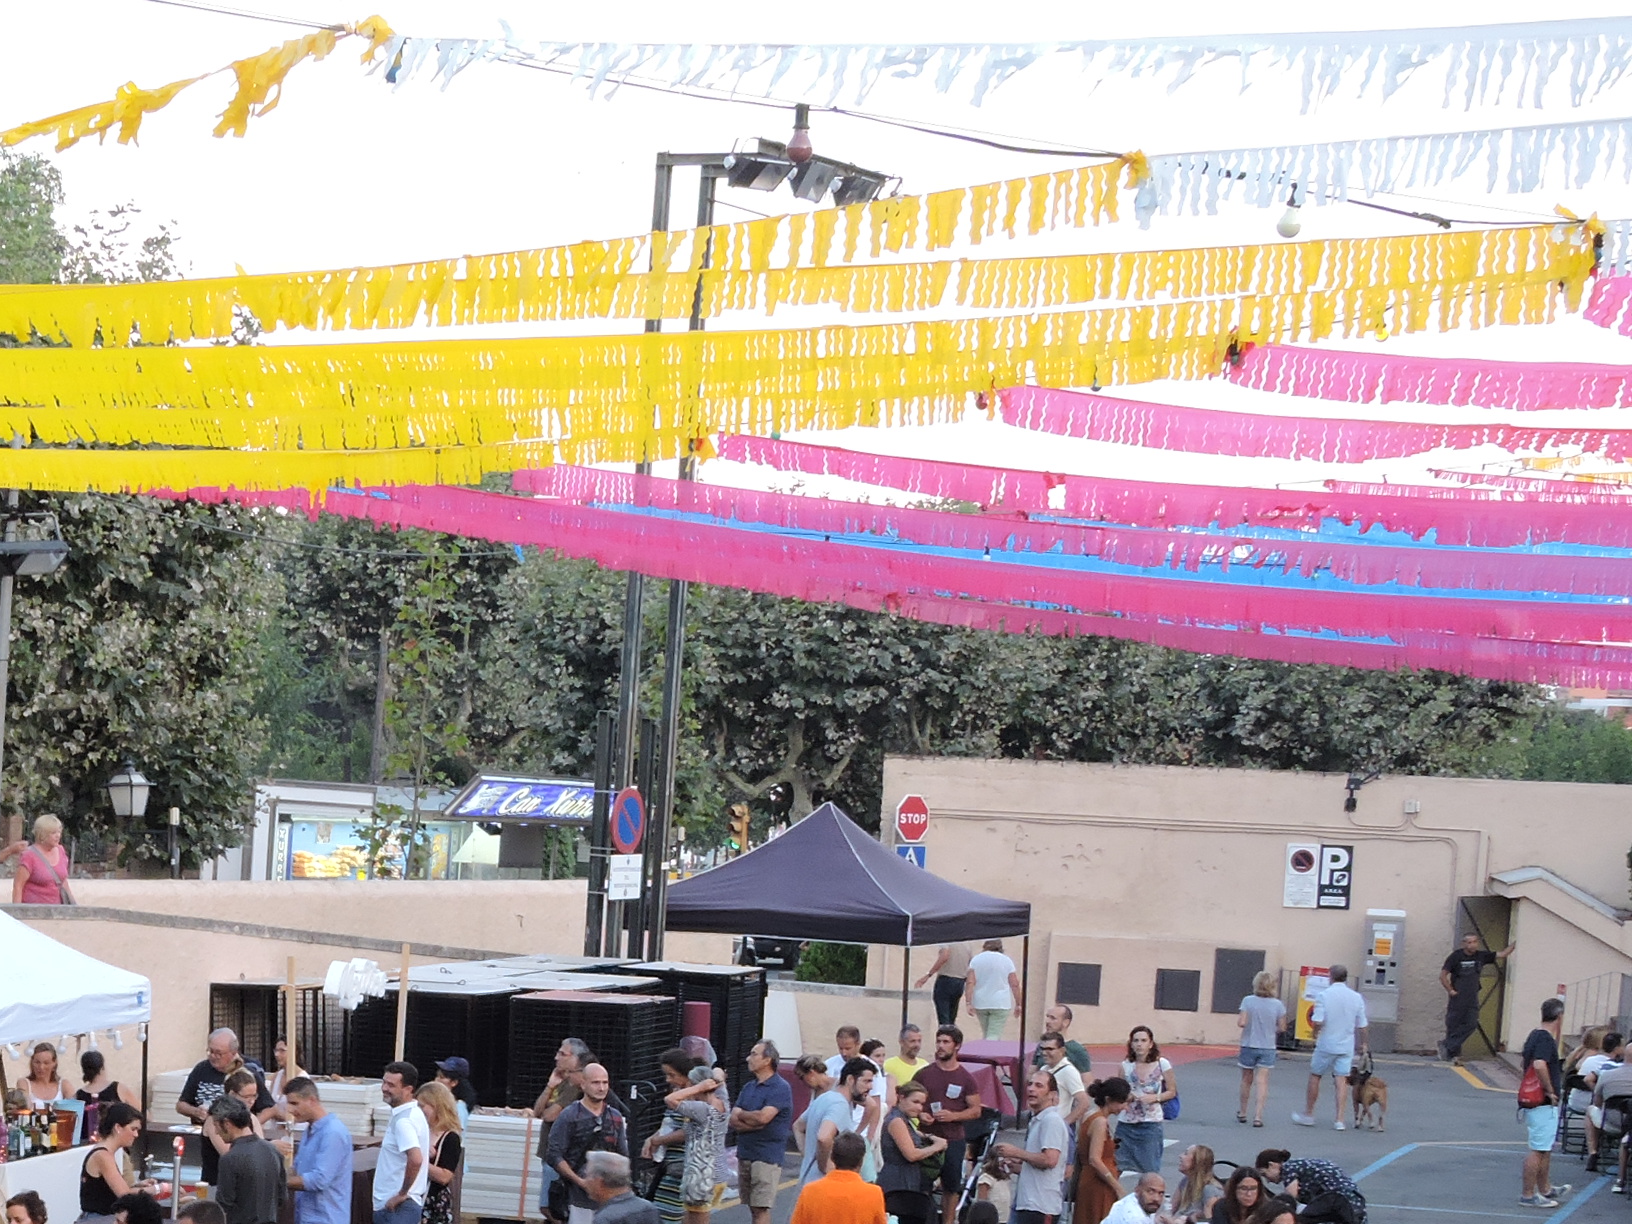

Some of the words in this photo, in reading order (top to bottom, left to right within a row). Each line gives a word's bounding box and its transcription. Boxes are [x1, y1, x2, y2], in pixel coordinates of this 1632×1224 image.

[499, 786, 542, 816] Can
[900, 813, 927, 825] STOP
[1320, 847, 1350, 885] P
